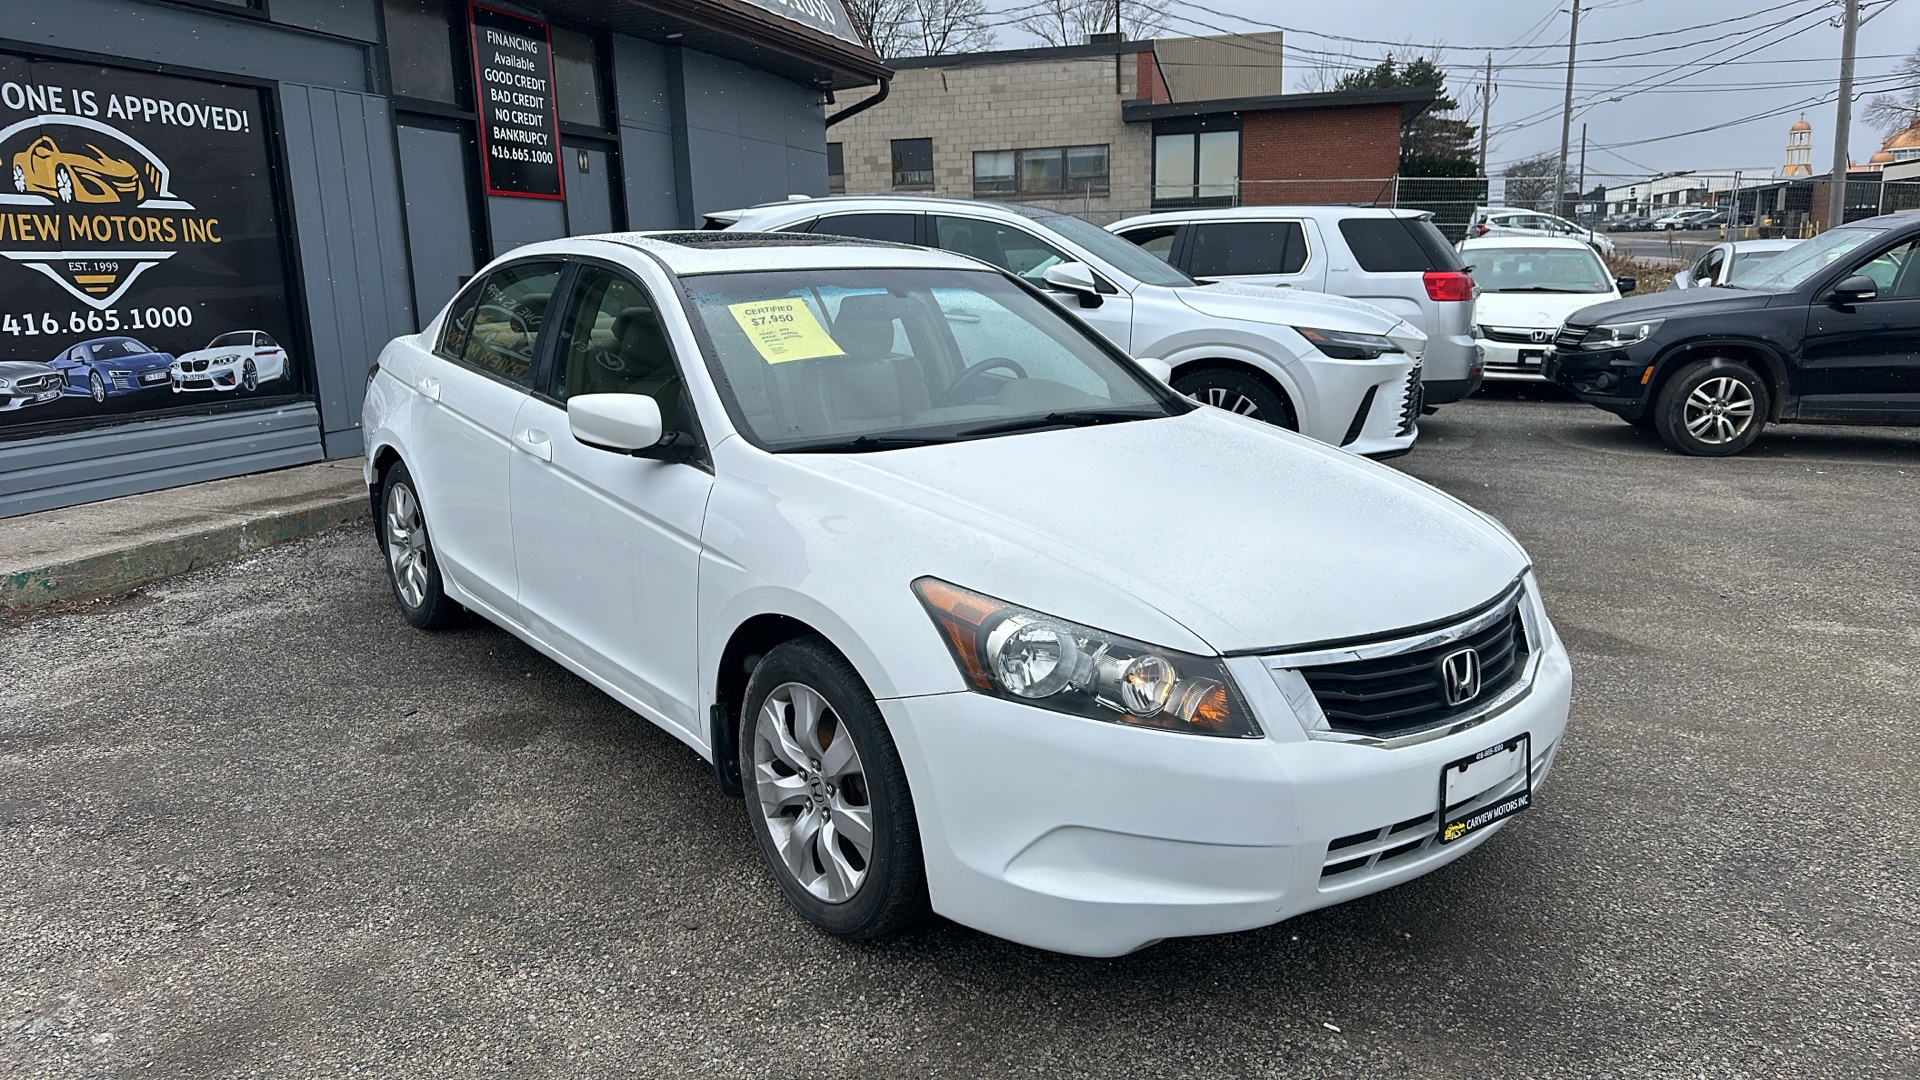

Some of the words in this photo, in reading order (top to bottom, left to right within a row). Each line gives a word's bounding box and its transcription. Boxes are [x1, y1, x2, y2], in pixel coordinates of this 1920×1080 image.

[486, 30, 538, 54] FINANCING
[494, 51, 535, 71] Available
[484, 68, 513, 85] GOOD
[514, 74, 546, 92] CREDIT
[1, 82, 66, 113] ONE
[72, 89, 99, 116] IS
[106, 94, 250, 133] APPROVED!
[490, 88, 511, 104] BAD
[512, 92, 544, 109] CREDIT
[495, 107, 510, 122] NO
[511, 110, 543, 127] CREDIT
[493, 126, 548, 146] BANKRUPCY
[491, 145, 553, 164] 416.665.1000
[68, 214, 177, 242] MOTORS
[181, 218, 222, 243] INC
[68, 262, 92, 271] EST.
[94, 261, 119, 272] 1999
[2, 305, 193, 336] 416.665.1000
[744, 305, 793, 316] CERTIFIED
[751, 314, 794, 327] $7,950
[1466, 809, 1494, 830] CARVIEW
[1493, 801, 1518, 818] MOTORS
[1518, 794, 1529, 808] INC
